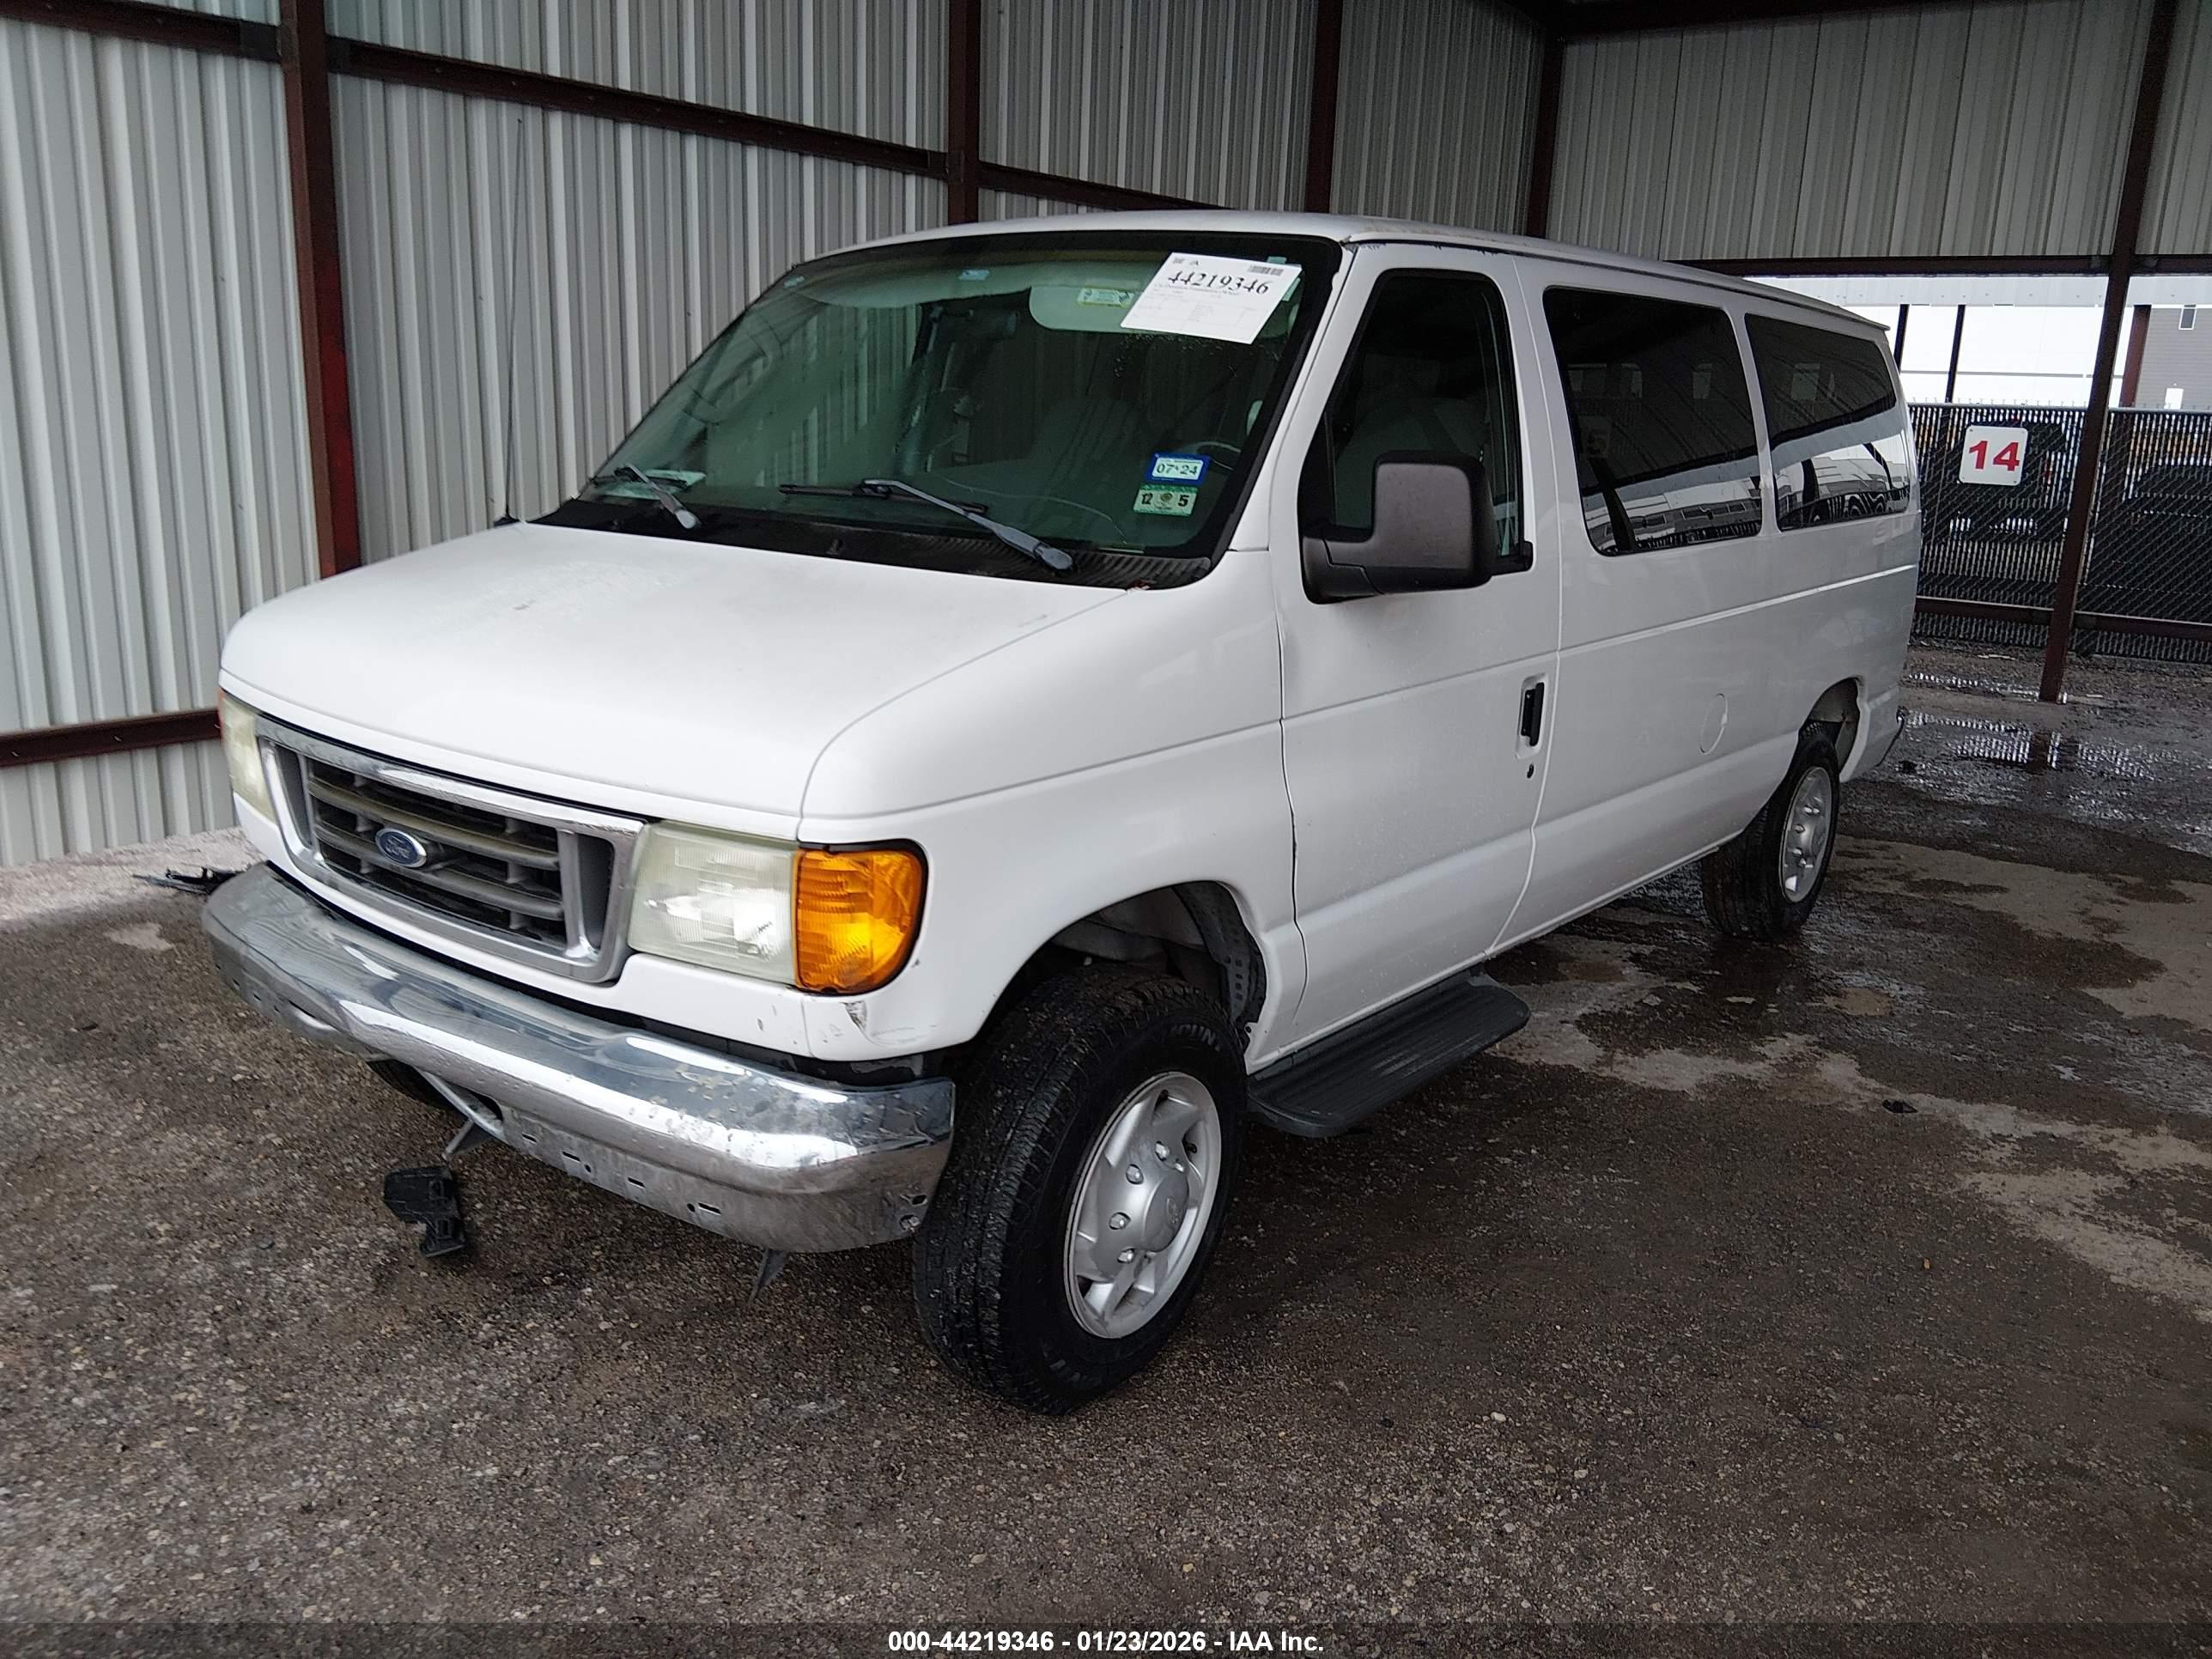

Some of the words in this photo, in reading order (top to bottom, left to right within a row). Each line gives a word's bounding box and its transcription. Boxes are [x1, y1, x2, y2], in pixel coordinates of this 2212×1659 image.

[1168, 270, 1273, 295] 44219346
[1968, 440, 2021, 471] 14
[1177, 494, 1189, 507] 5
